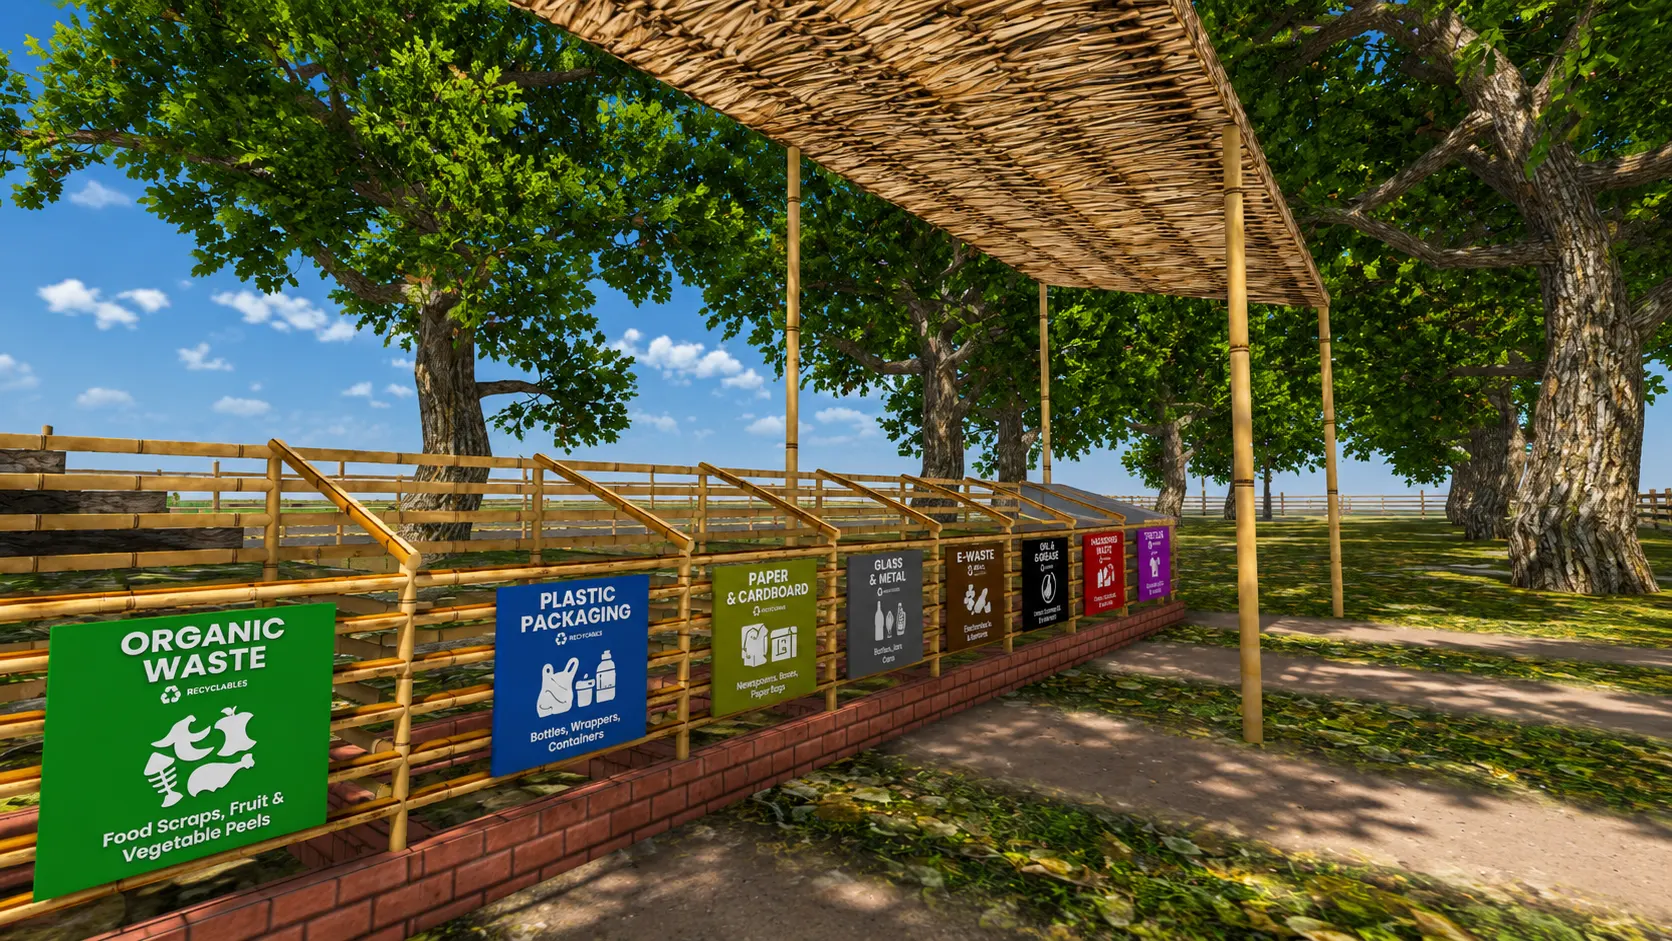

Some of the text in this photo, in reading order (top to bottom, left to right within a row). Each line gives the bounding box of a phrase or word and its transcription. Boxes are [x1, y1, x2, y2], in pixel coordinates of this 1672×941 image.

[874, 557, 903, 571] GLASS
[957, 549, 995, 563] E-WASTE
[748, 569, 788, 586] PAPER
[869, 571, 906, 586] & METAL
[540, 586, 616, 610] PLASTIC
[727, 583, 809, 605] & CARDBOARD
[521, 604, 631, 633] PACKAGING
[121, 617, 285, 656] ORGANIC
[143, 646, 266, 683] WASTE
[187, 679, 248, 695] RECYCLABLES
[530, 713, 620, 742] Bottles, Wrappers,
[548, 730, 604, 752] Containers
[103, 791, 284, 847] Food Scraps, Fruit &
[122, 813, 271, 863] Vegetable Peels
